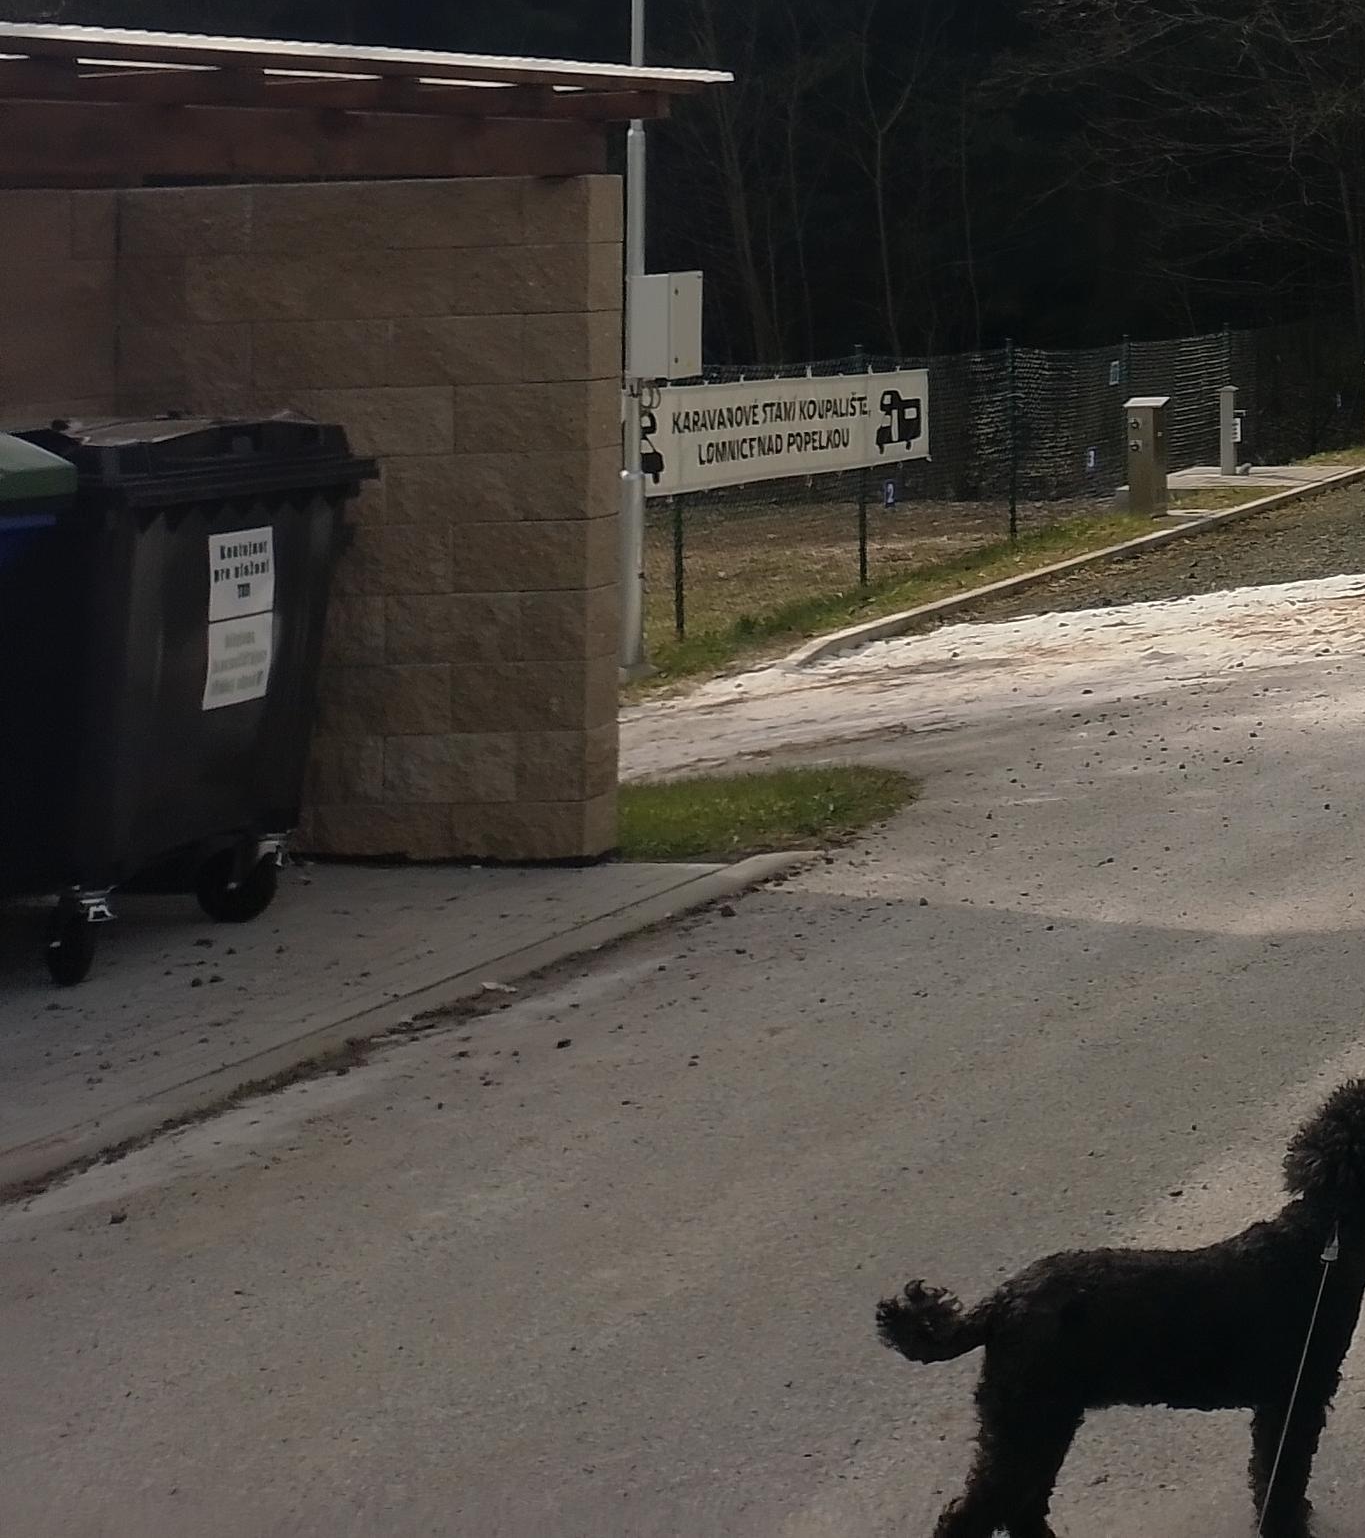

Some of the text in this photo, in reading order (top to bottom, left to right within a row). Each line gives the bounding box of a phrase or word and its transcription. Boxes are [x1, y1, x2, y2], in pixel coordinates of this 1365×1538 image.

[671, 398, 760, 435] KARAVANOVÉ
[761, 395, 797, 425] STÁNÍ
[697, 428, 850, 466] LOMNICE NAD POPELKOU
